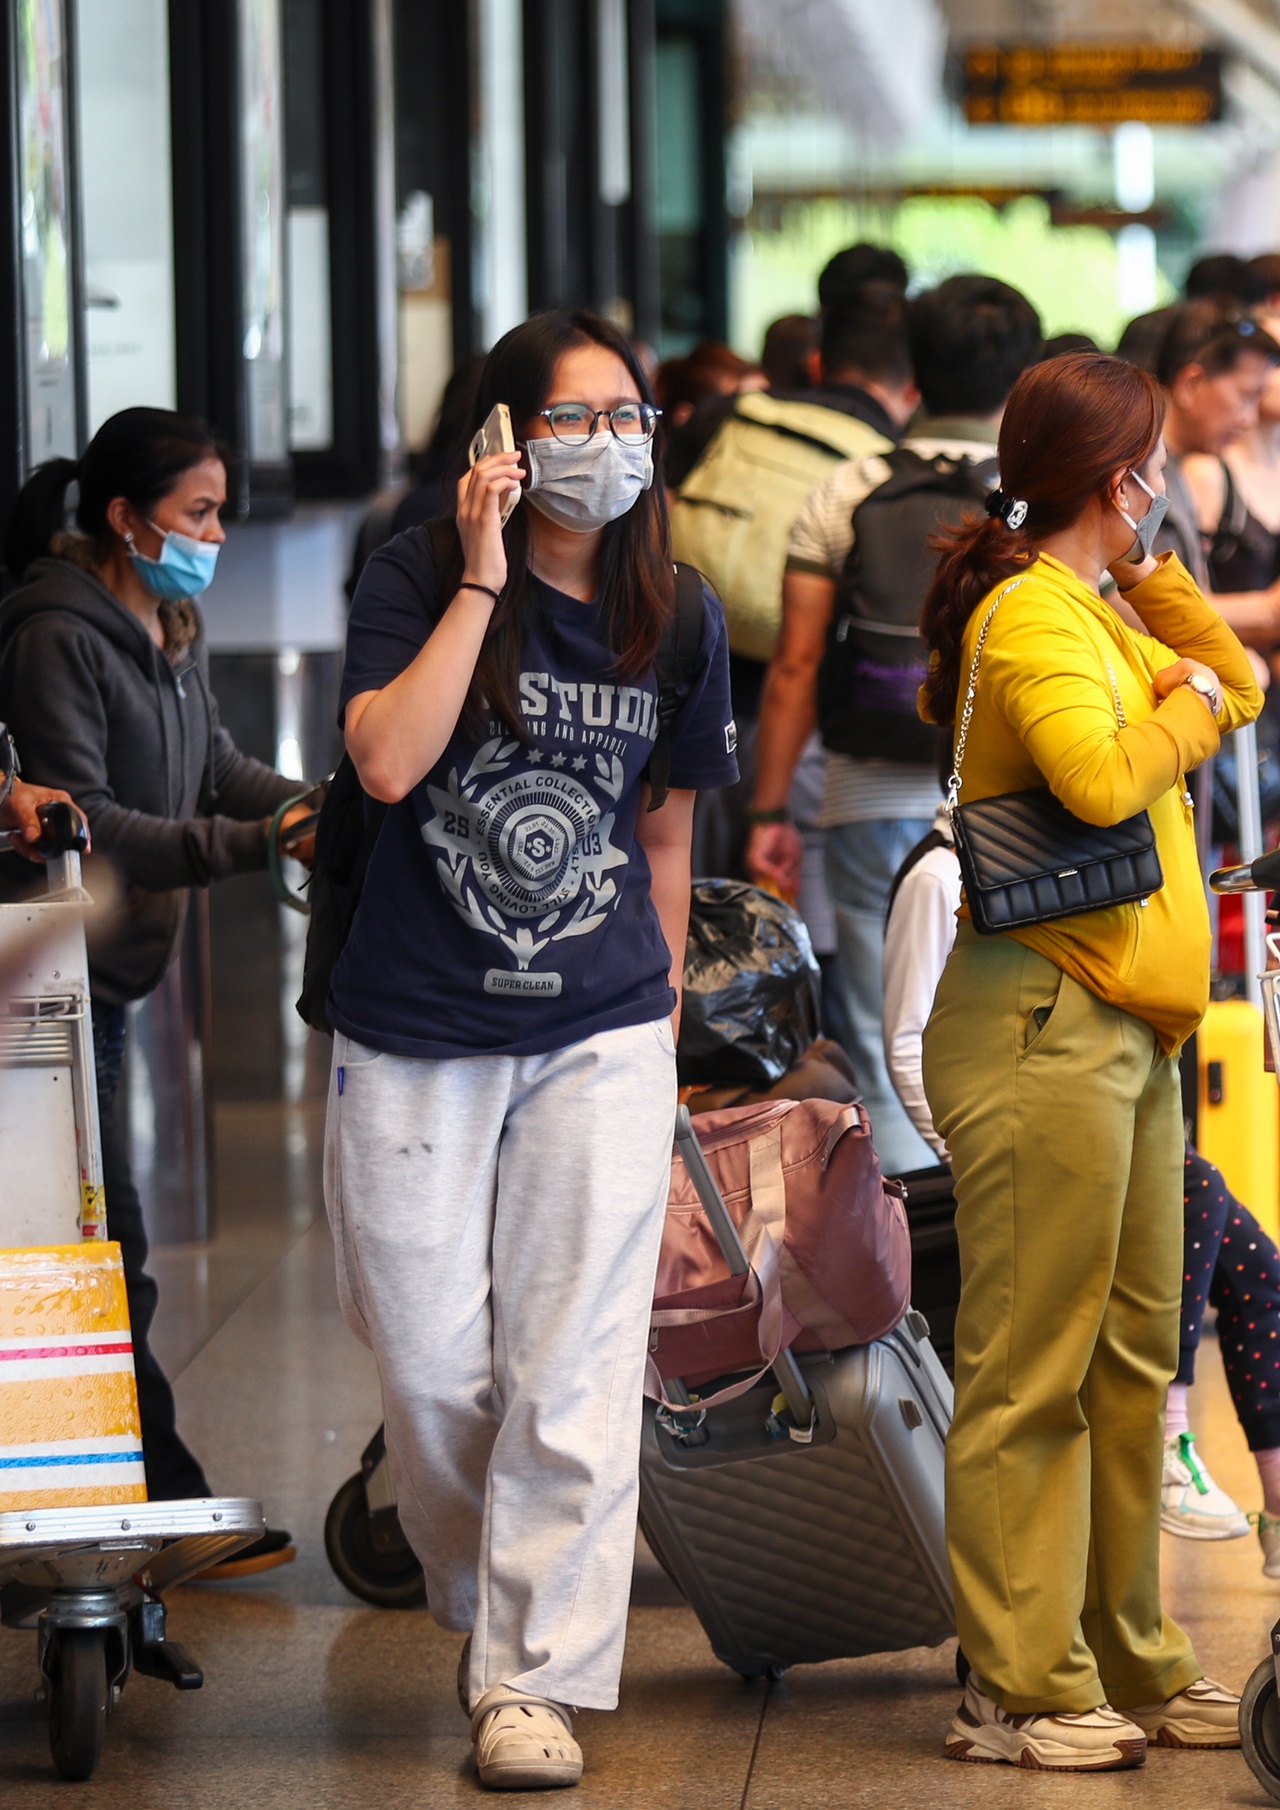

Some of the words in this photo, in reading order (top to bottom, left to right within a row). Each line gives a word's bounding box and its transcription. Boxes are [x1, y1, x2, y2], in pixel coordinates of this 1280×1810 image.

[554, 723, 575, 741] AND
[582, 730, 627, 757] APPAREL
[477, 779, 531, 836] ESSENTIAL
[443, 810, 470, 839] 25
[531, 837, 545, 858] S
[478, 852, 493, 881] YOU
[489, 884, 537, 914] LOVING
[542, 887, 570, 910] STILL
[491, 977, 521, 989] SUPER
[523, 981, 554, 991] CLEAN
